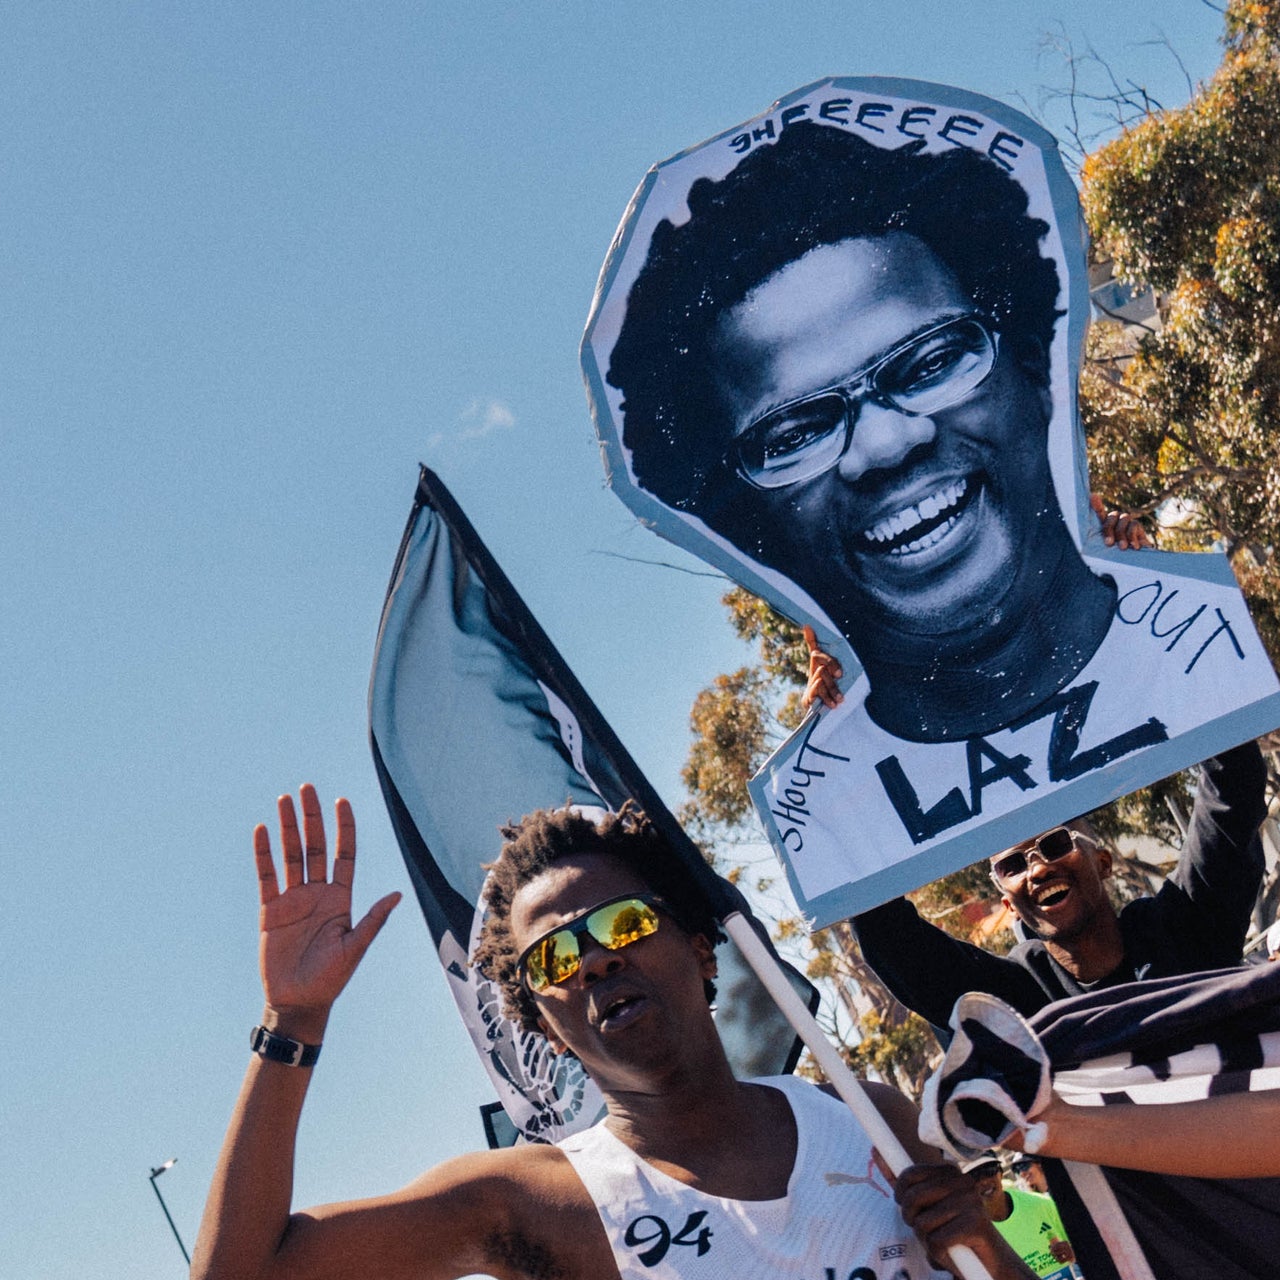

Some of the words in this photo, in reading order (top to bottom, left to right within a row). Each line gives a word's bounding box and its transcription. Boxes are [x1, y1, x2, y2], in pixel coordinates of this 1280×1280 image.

[1116, 580, 1245, 674] OUT
[772, 713, 850, 852] SHOUT
[874, 680, 1169, 846] LAZ
[624, 1210, 714, 1268] 94
